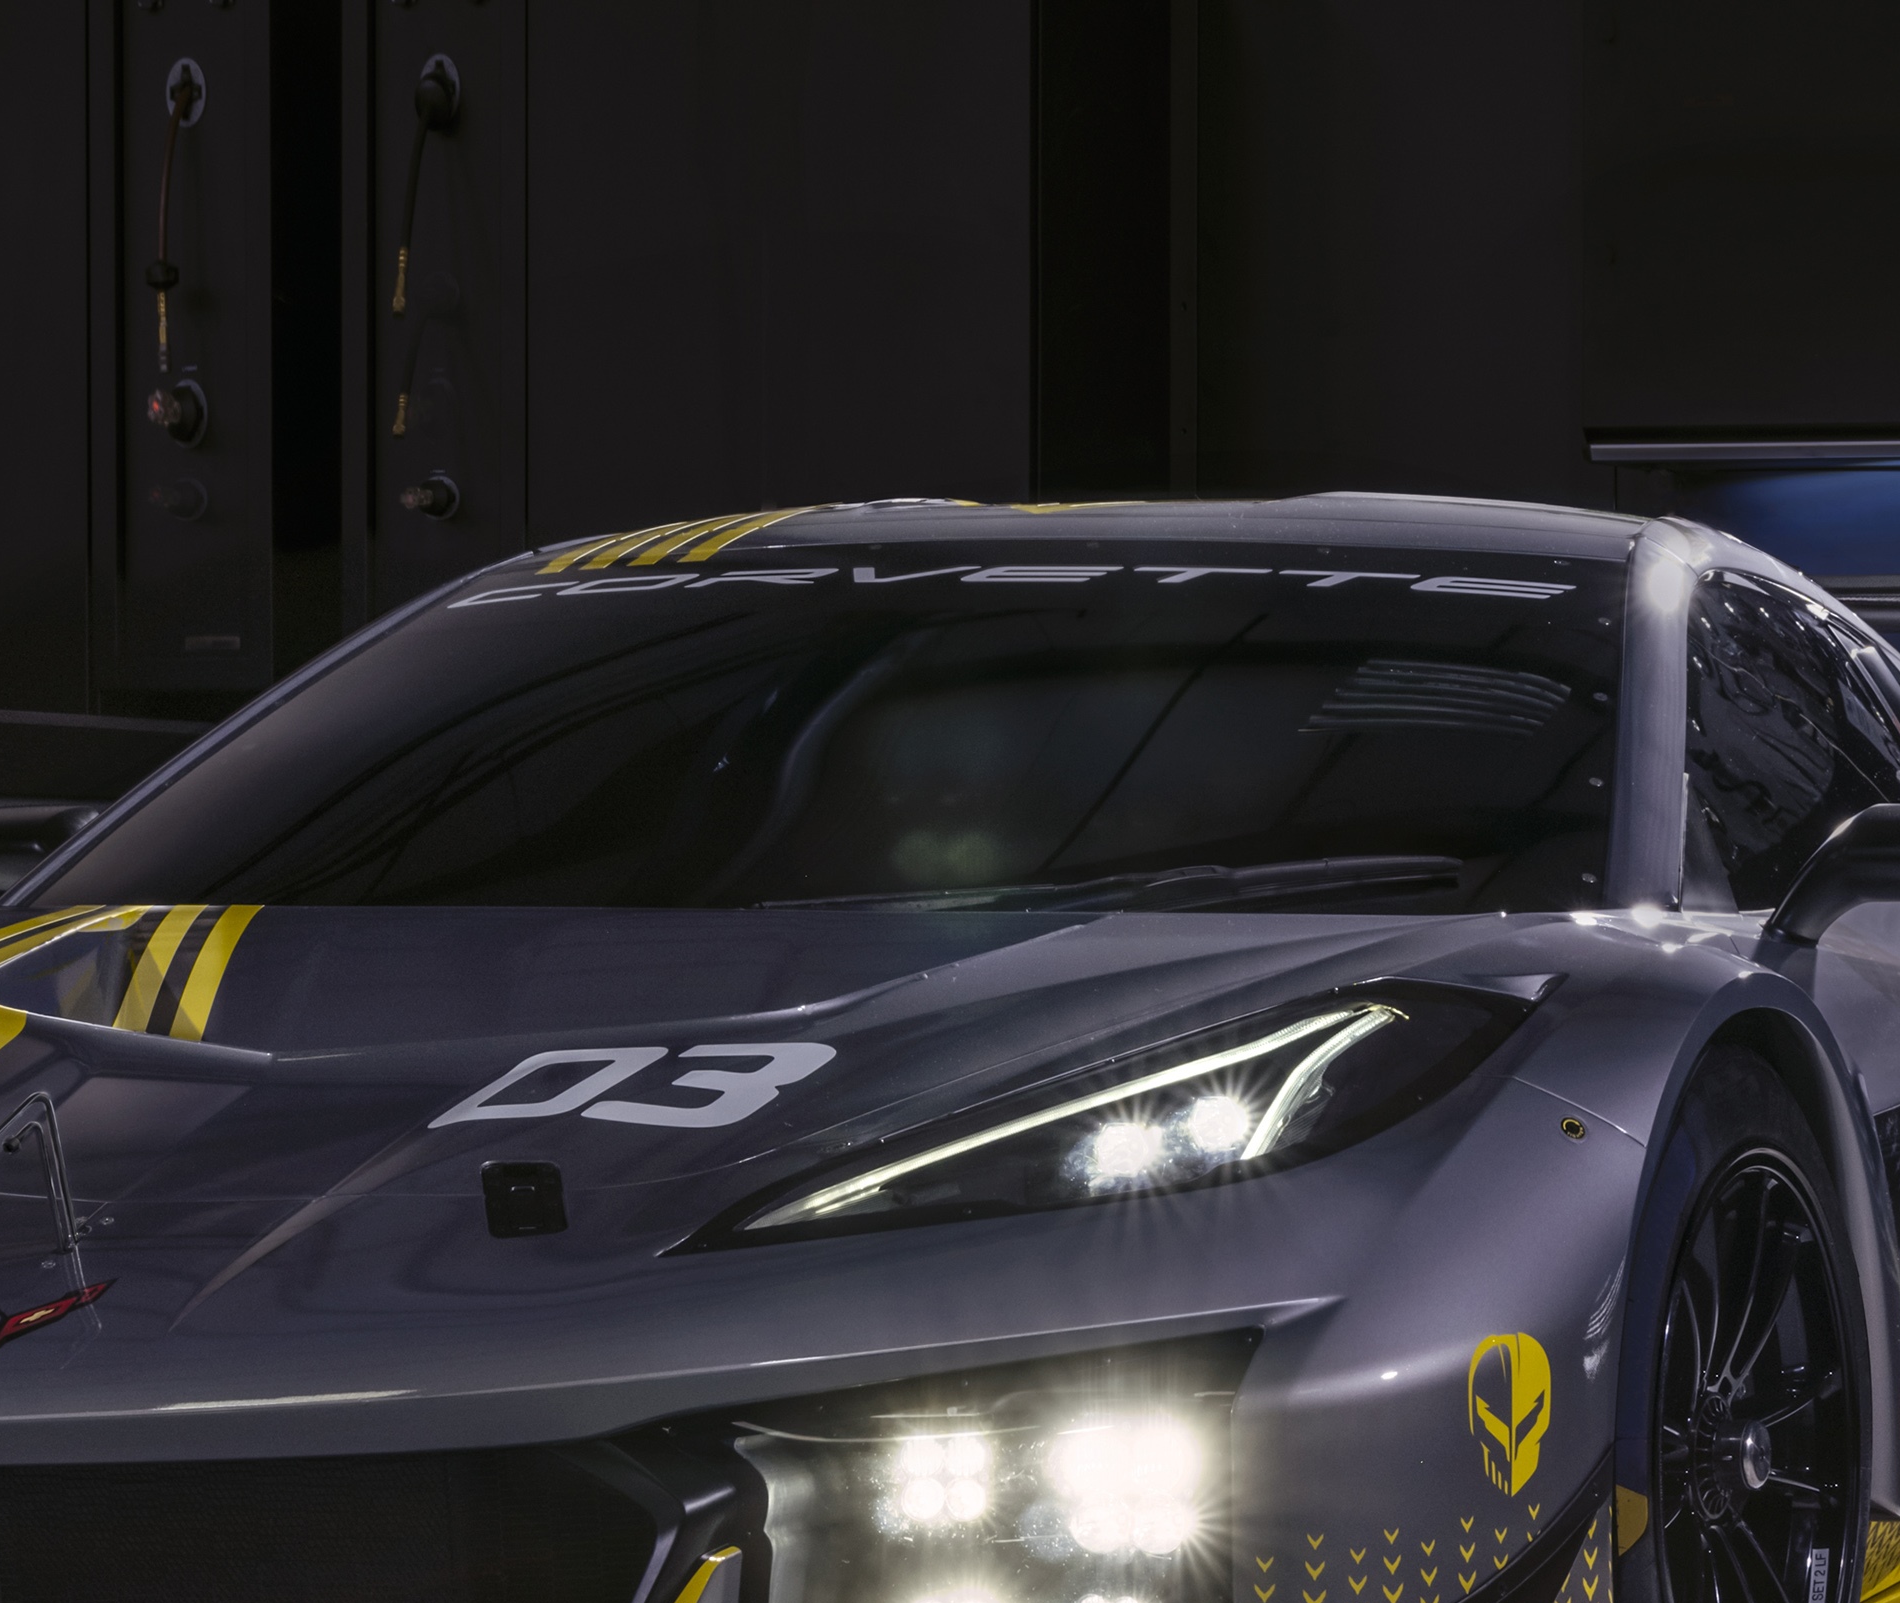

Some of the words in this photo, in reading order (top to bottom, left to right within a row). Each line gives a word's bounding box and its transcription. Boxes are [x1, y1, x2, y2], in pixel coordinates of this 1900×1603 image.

[448, 565, 1578, 609] CORVETTE
[427, 1040, 838, 1129] 03
[1814, 1553, 1827, 1567] LF
[1811, 1579, 1825, 1602] SET
